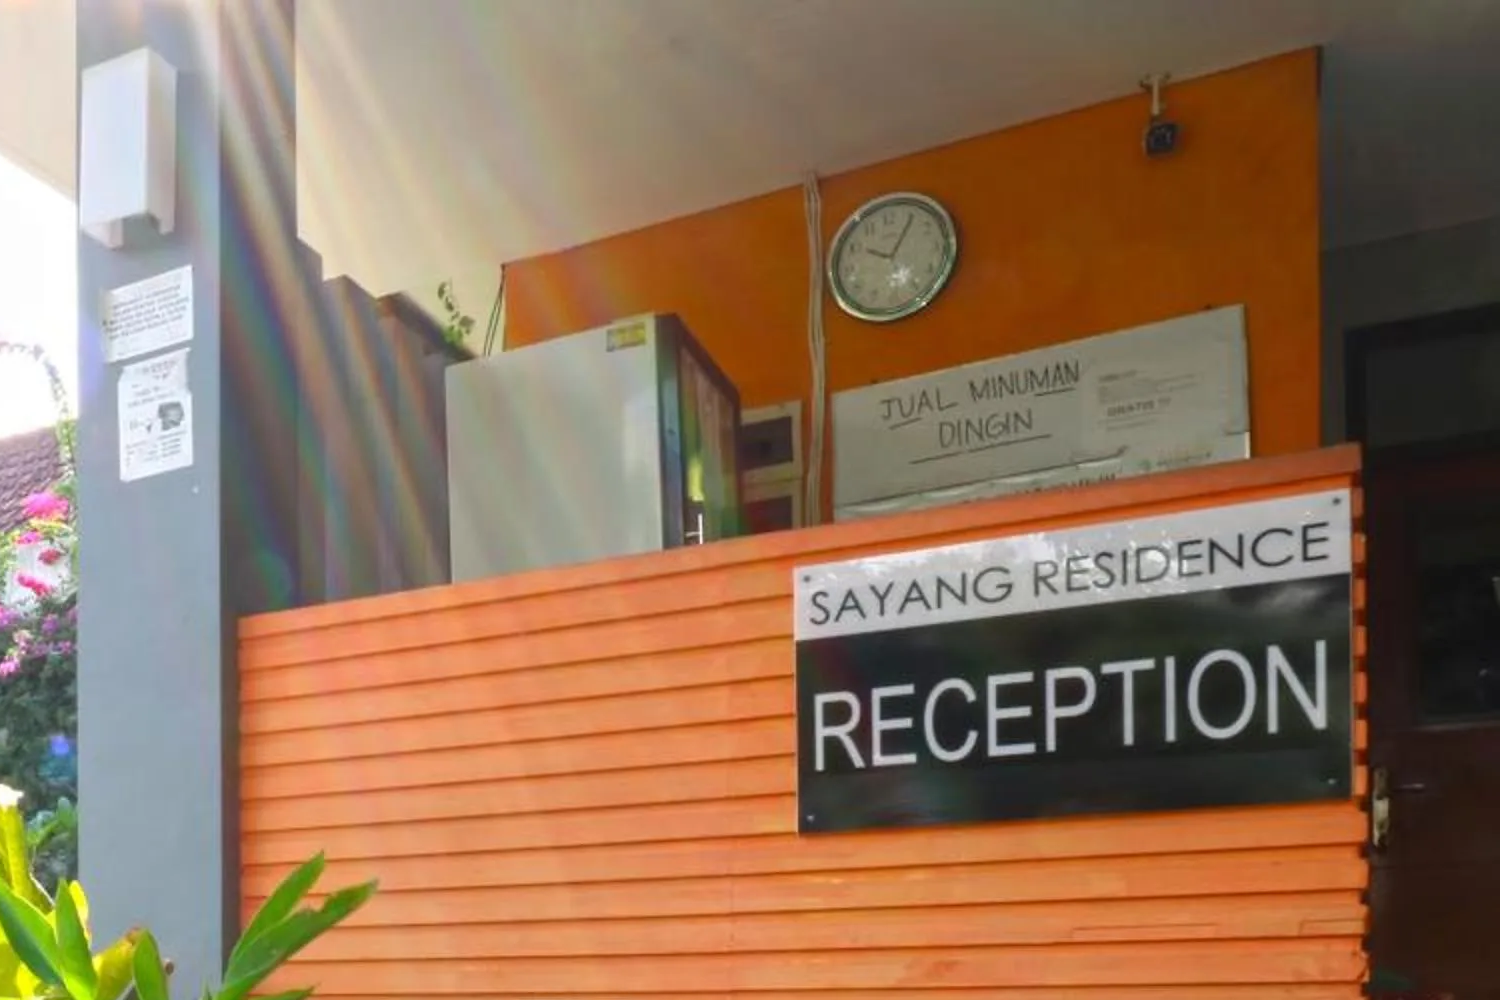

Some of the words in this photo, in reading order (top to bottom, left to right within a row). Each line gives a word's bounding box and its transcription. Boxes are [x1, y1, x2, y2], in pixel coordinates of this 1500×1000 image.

[880, 386, 956, 423] JUAL
[969, 359, 1082, 401] MINUMAN
[939, 409, 1034, 448] DINGIN
[809, 566, 1013, 626] SAYANG
[1033, 521, 1330, 598] RESIDENCE
[813, 639, 1328, 772] RECEPTION
